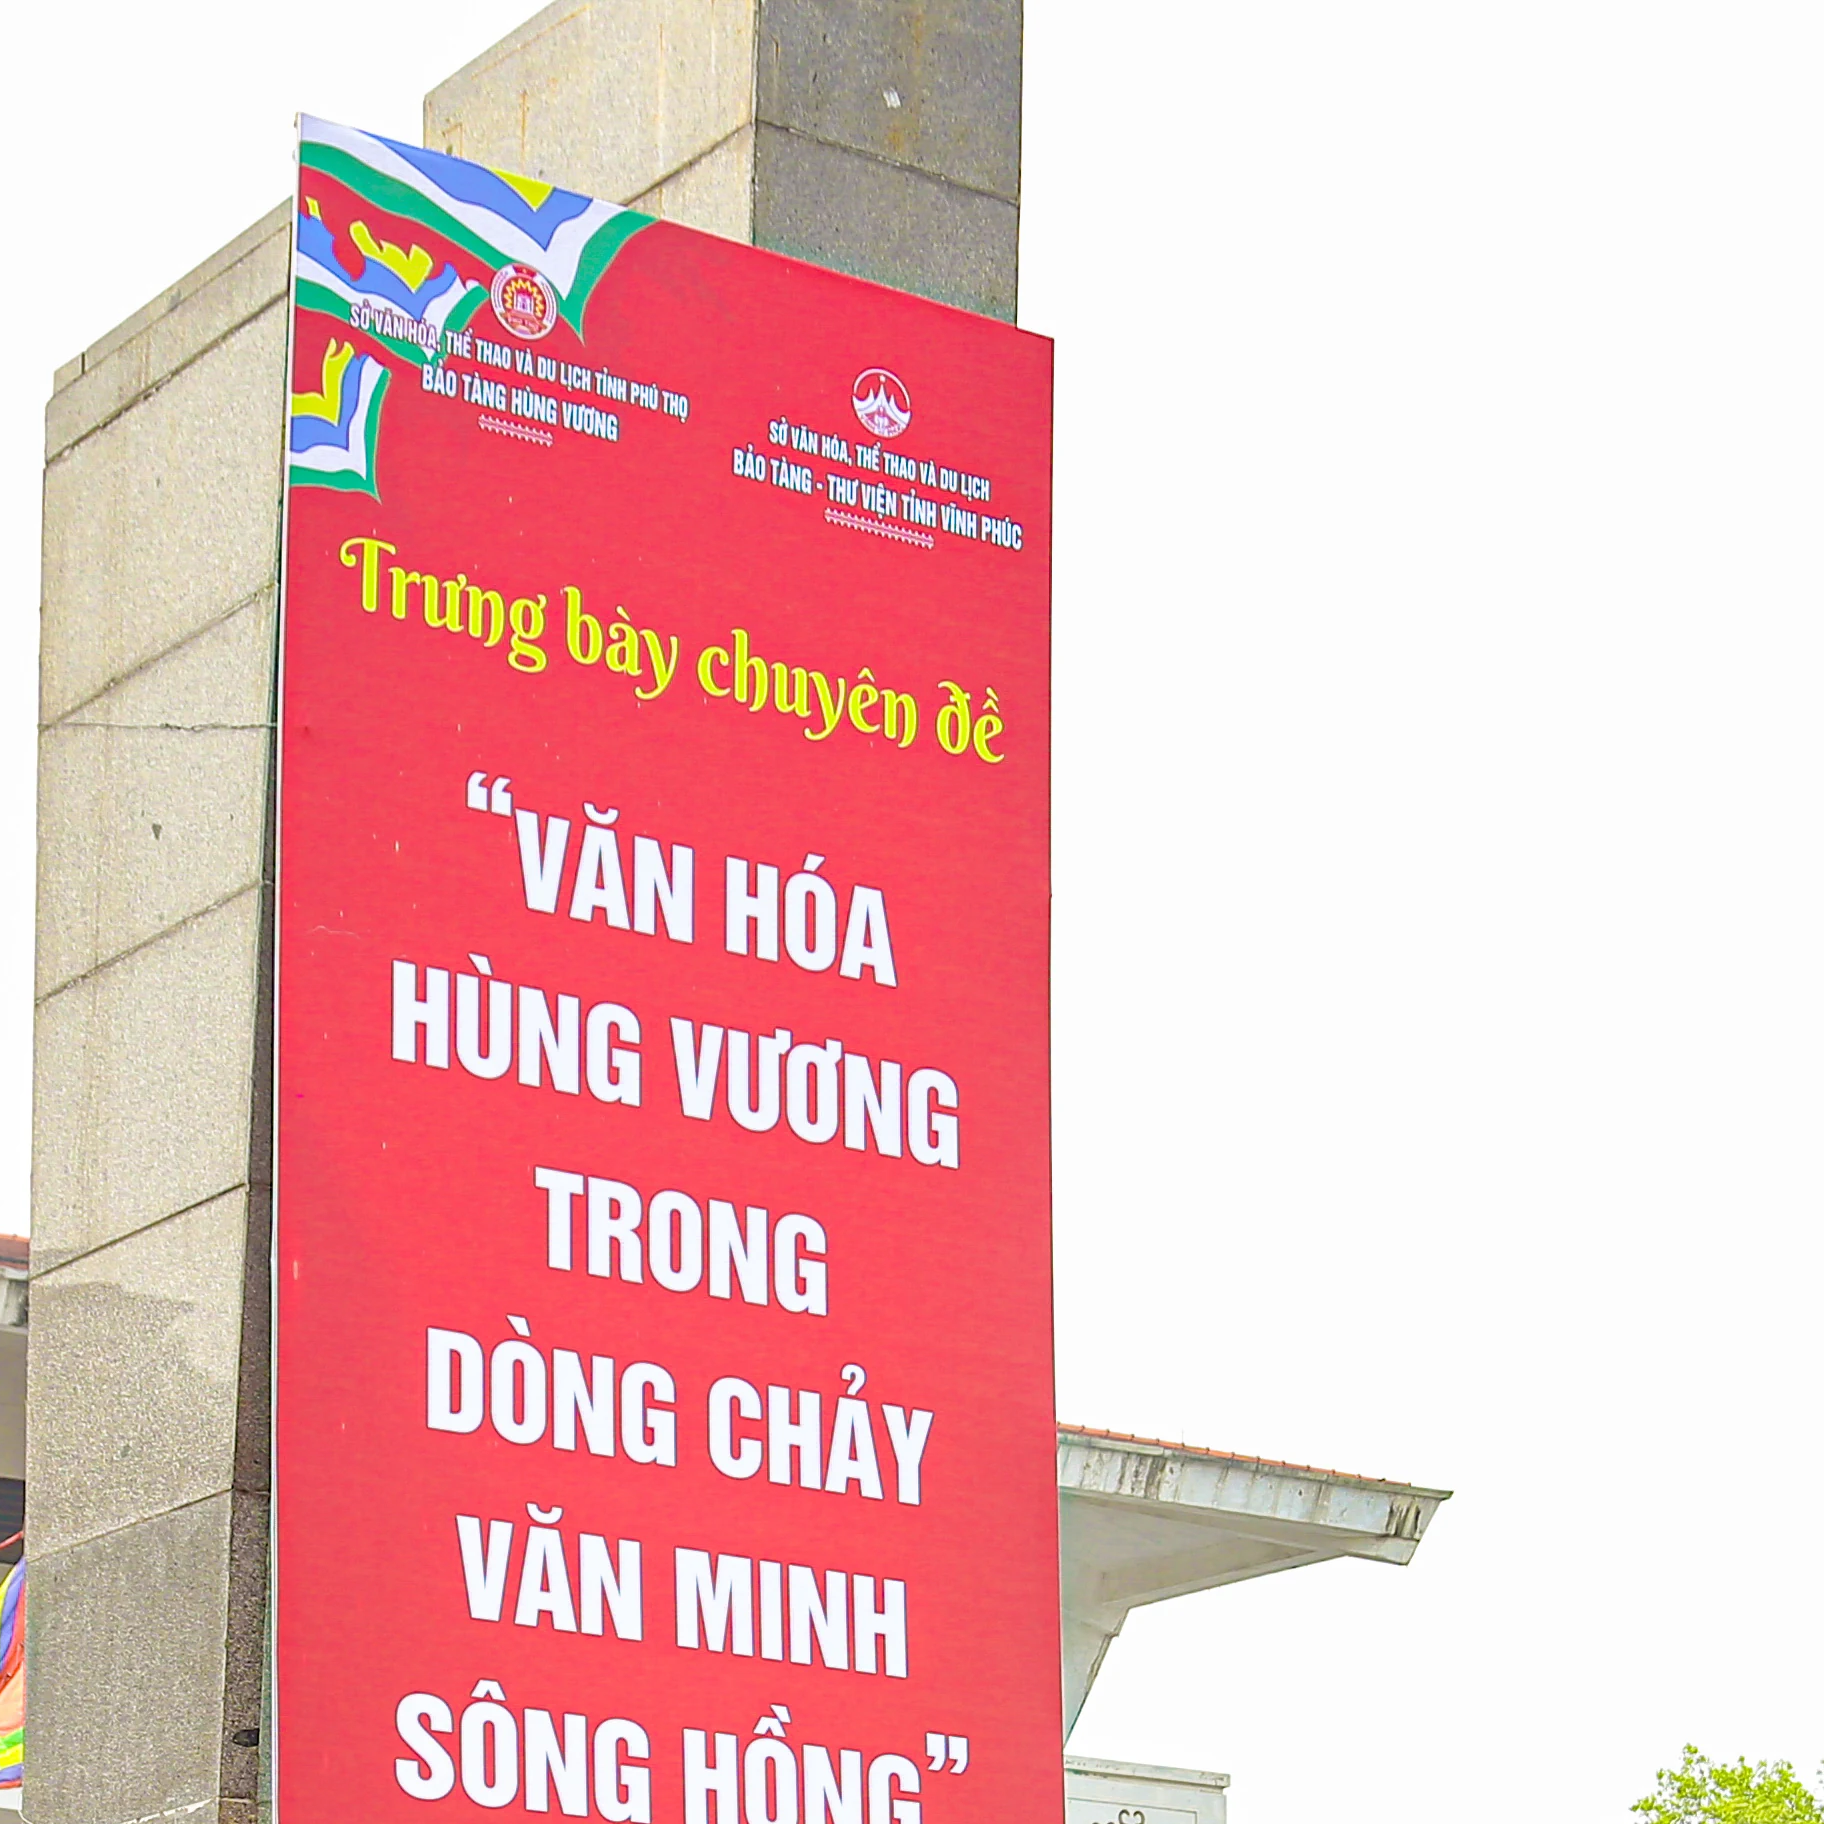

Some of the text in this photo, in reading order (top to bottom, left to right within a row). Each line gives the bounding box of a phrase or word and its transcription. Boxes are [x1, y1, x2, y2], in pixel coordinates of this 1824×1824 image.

[350, 299, 371, 330] SỞ
[373, 304, 404, 340] VĂN
[445, 327, 474, 358] THỂ
[475, 338, 512, 372] THAO
[514, 347, 534, 377] VÀ
[537, 358, 556, 383] DU
[560, 361, 592, 393] LỊCH
[594, 366, 628, 403] TỈNH
[630, 382, 659, 410] PHÚ
[661, 389, 689, 424] THỌ
[421, 358, 620, 442] BẢO TÀNG HÙNG VƯƠNG
[732, 443, 766, 483] BẢO
[769, 456, 814, 496] TÀNG
[826, 473, 860, 507] THƯ
[861, 481, 898, 520] VIỆN
[900, 488, 938, 528] TỈNH
[939, 503, 978, 539] VĨNH
[980, 515, 1024, 552] PHÚC
[768, 415, 991, 502] SỞ VĂN HÓA, THỂ THAO VÀ DU LỊCH
[338, 535, 1005, 764] Trưng bày chuyên đề
[724, 852, 899, 989] HÓA
[390, 952, 961, 1170] HÙNG VƯƠNG
[533, 1164, 829, 1317] TRONG
[425, 1313, 935, 1507] DÒNG CHẢY
[455, 1501, 909, 1680] VĂN MINH
